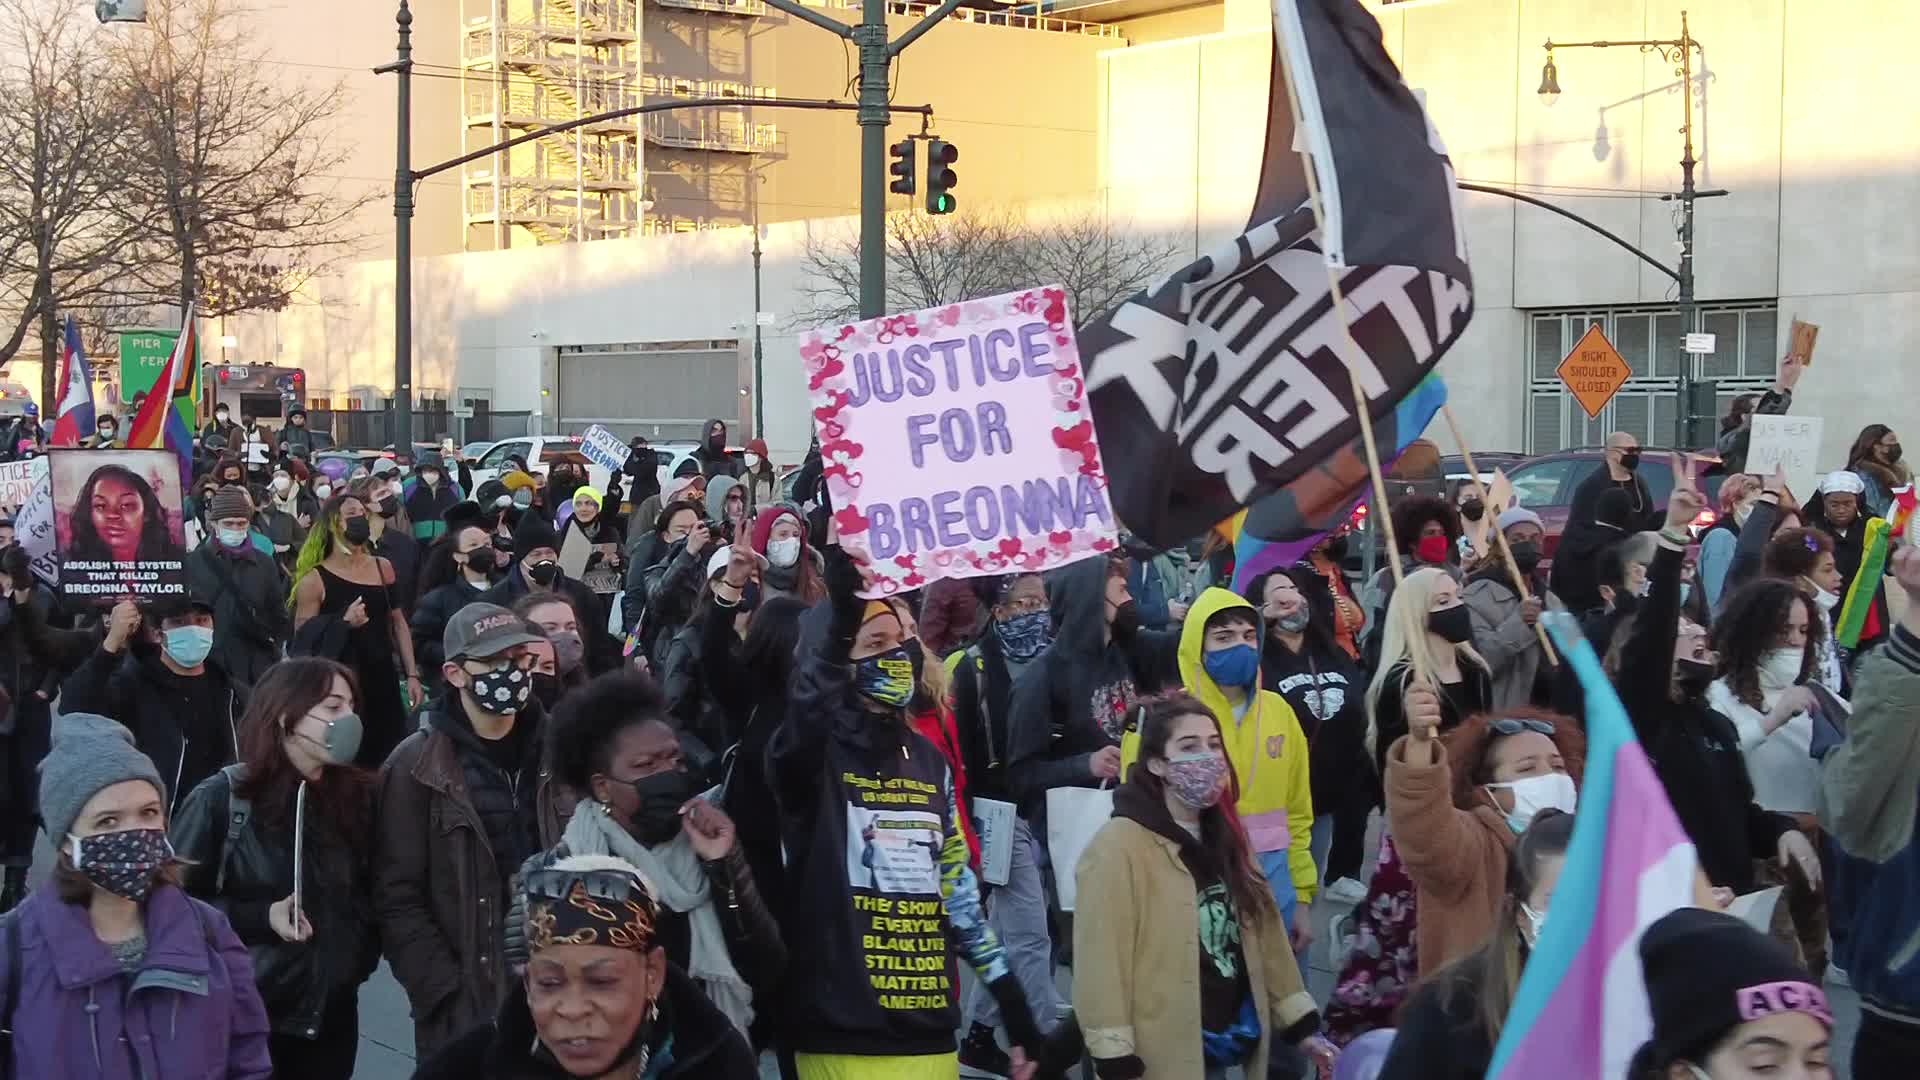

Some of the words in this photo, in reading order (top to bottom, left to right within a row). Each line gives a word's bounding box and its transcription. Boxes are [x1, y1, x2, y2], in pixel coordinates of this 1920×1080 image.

[132, 338, 161, 349] PIER
[847, 321, 1055, 408] JUSTICE
[1581, 351, 1607, 362] RIGHT
[1570, 366, 1617, 377] SHOULDER
[1576, 381, 1611, 393] CLOSED
[591, 426, 629, 459] JUSTICE
[906, 400, 1013, 469] FOR
[866, 473, 1111, 561] BREONNA
[63, 561, 111, 570] ABOLISH
[112, 561, 136, 570] THE
[137, 561, 182, 570] SYSTEM
[87, 572, 116, 580] THAT
[118, 572, 159, 580] KILLED
[64, 583, 129, 594] BREONNA
[131, 583, 185, 594] TAYLOR
[852, 895, 893, 914] THEY
[897, 900, 939, 916] SHOW
[863, 934, 917, 952] BLACK
[864, 954, 915, 971] STILL
[869, 974, 938, 991] MATTER
[878, 994, 949, 1010] AMERICA
